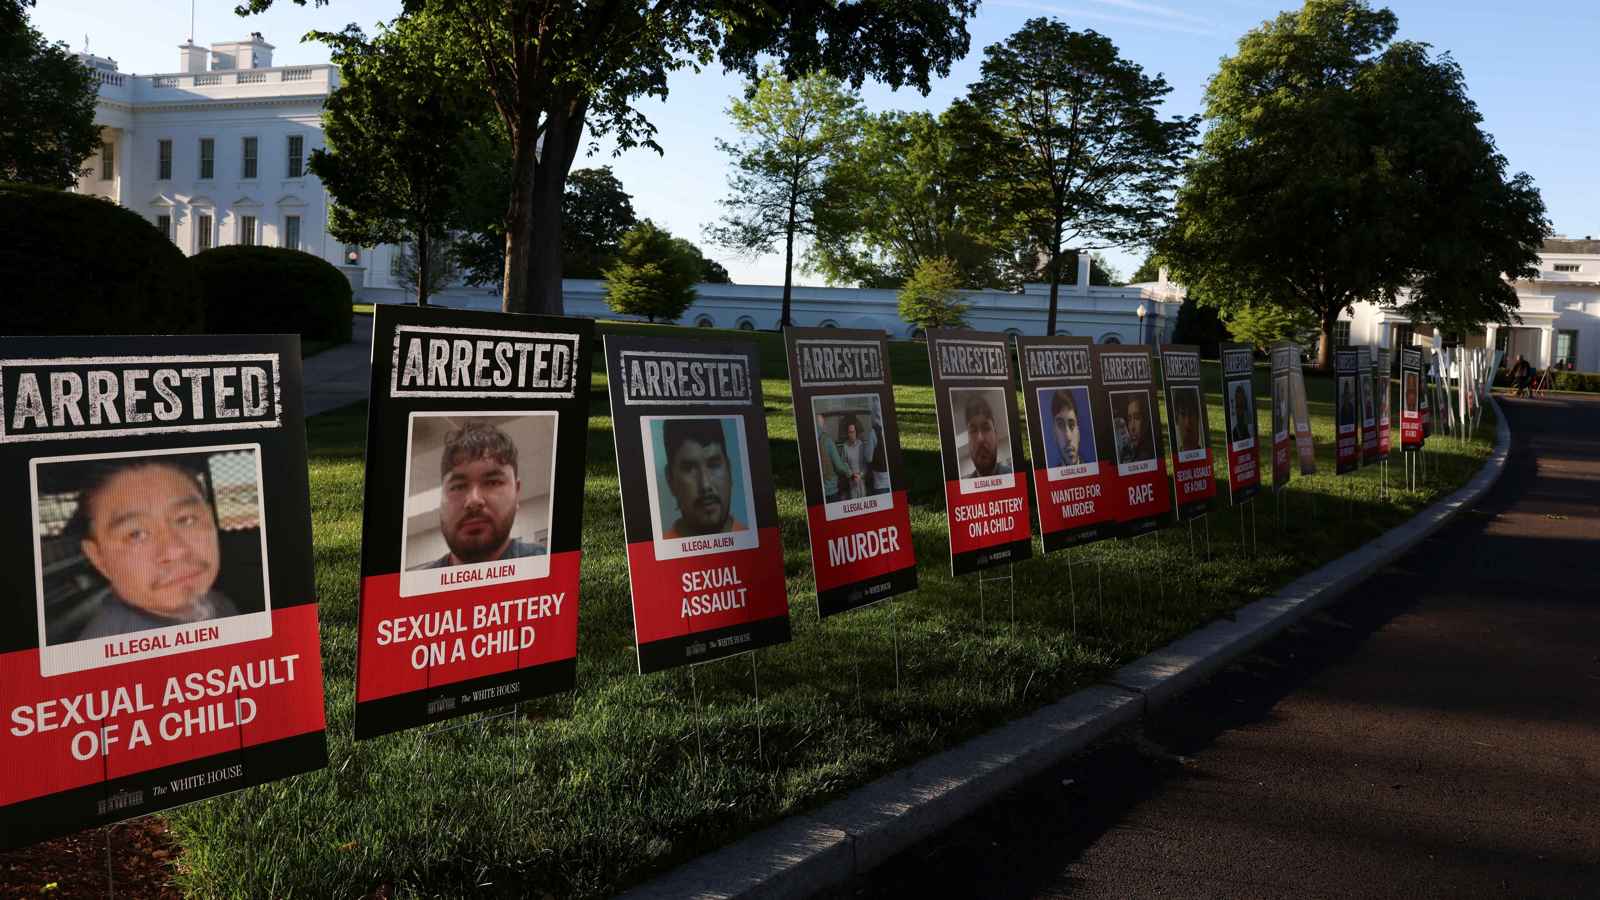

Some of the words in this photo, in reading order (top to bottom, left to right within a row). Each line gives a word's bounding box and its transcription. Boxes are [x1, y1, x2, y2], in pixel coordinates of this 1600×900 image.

[401, 337, 570, 388] ARRESTED
[802, 347, 880, 380] ARRESTED
[941, 346, 1005, 374] ARRESTED
[1029, 350, 1089, 375] ARRESTED
[1104, 357, 1149, 379] ARRESTED
[1167, 357, 1200, 377] ARRESTED
[630, 360, 746, 398] ARRESTED
[12, 366, 270, 431] ARRESTED
[1051, 487, 1085, 504] WANTED
[1086, 484, 1101, 497] FOR
[1128, 484, 1153, 505] RAPE
[843, 503, 862, 513] ILLEGAL
[955, 503, 988, 522] SEXUAL
[989, 497, 1023, 516] BATTERY
[1062, 501, 1095, 518] MURDER
[969, 524, 983, 538] ON
[984, 523, 990, 536] A
[990, 518, 1014, 533] CHILD
[682, 540, 712, 552] ILLEGAL
[711, 537, 734, 550] ALIEN
[828, 526, 900, 567] MURDER
[440, 568, 483, 586] ILLEGAL
[484, 565, 515, 582] ALIEN
[682, 566, 742, 592] SEXUAL
[680, 588, 747, 618] ASSAULT
[376, 609, 467, 646] SEXUAL
[473, 593, 565, 631] BATTERY
[104, 632, 173, 659] ILLEGAL
[174, 625, 219, 650] ALIEN
[411, 643, 445, 670] ON
[450, 639, 466, 664] A
[471, 626, 535, 660] CHILD
[9, 681, 154, 738] SEXUAL
[162, 655, 300, 706] ASSAULT
[472, 686, 495, 701] WHITE
[496, 681, 520, 697] HOUSE
[70, 726, 121, 762] OF
[127, 718, 152, 751] A
[159, 697, 257, 743] CHILD
[152, 784, 168, 797] The
[170, 771, 204, 793] WHITE
[206, 764, 243, 788] HOUSE
